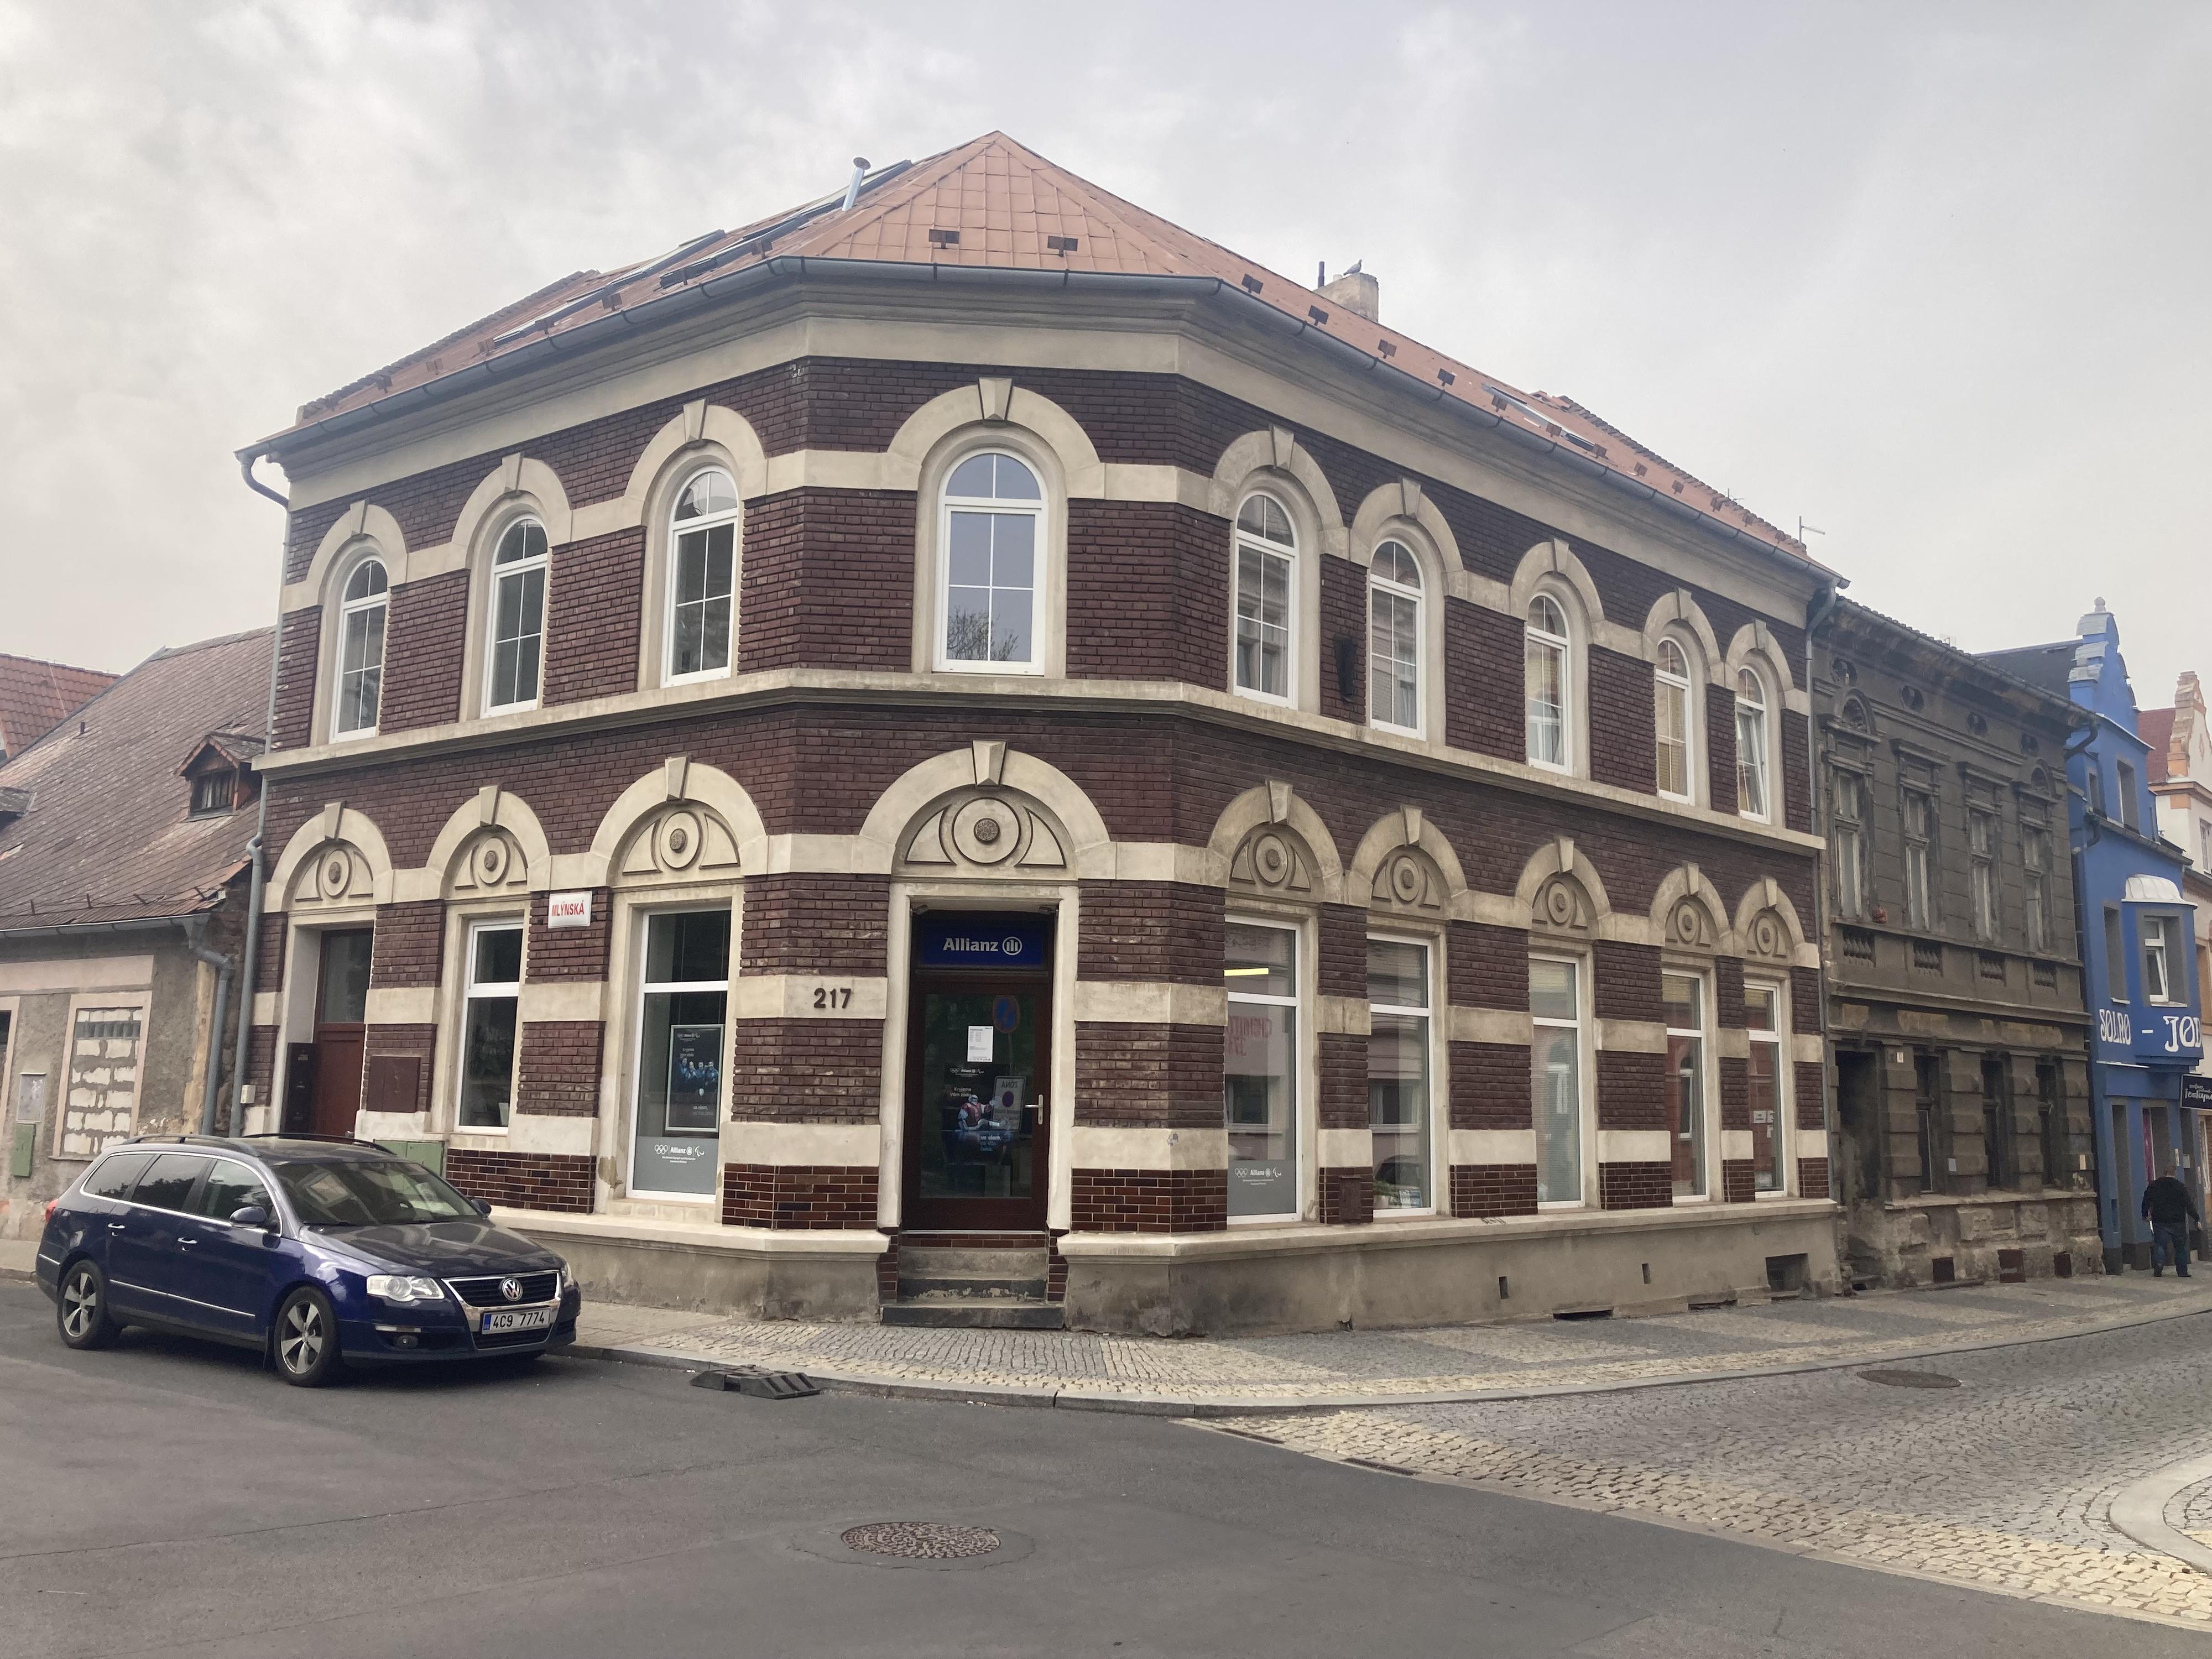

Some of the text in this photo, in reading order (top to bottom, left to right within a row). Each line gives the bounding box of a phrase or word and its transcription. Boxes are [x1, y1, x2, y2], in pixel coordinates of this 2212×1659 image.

[551, 900, 585, 917] MLÝNSKÁ
[943, 938, 999, 952] Allianz
[813, 988, 852, 1009] 217
[493, 1311, 544, 1328] 4C9 7774
